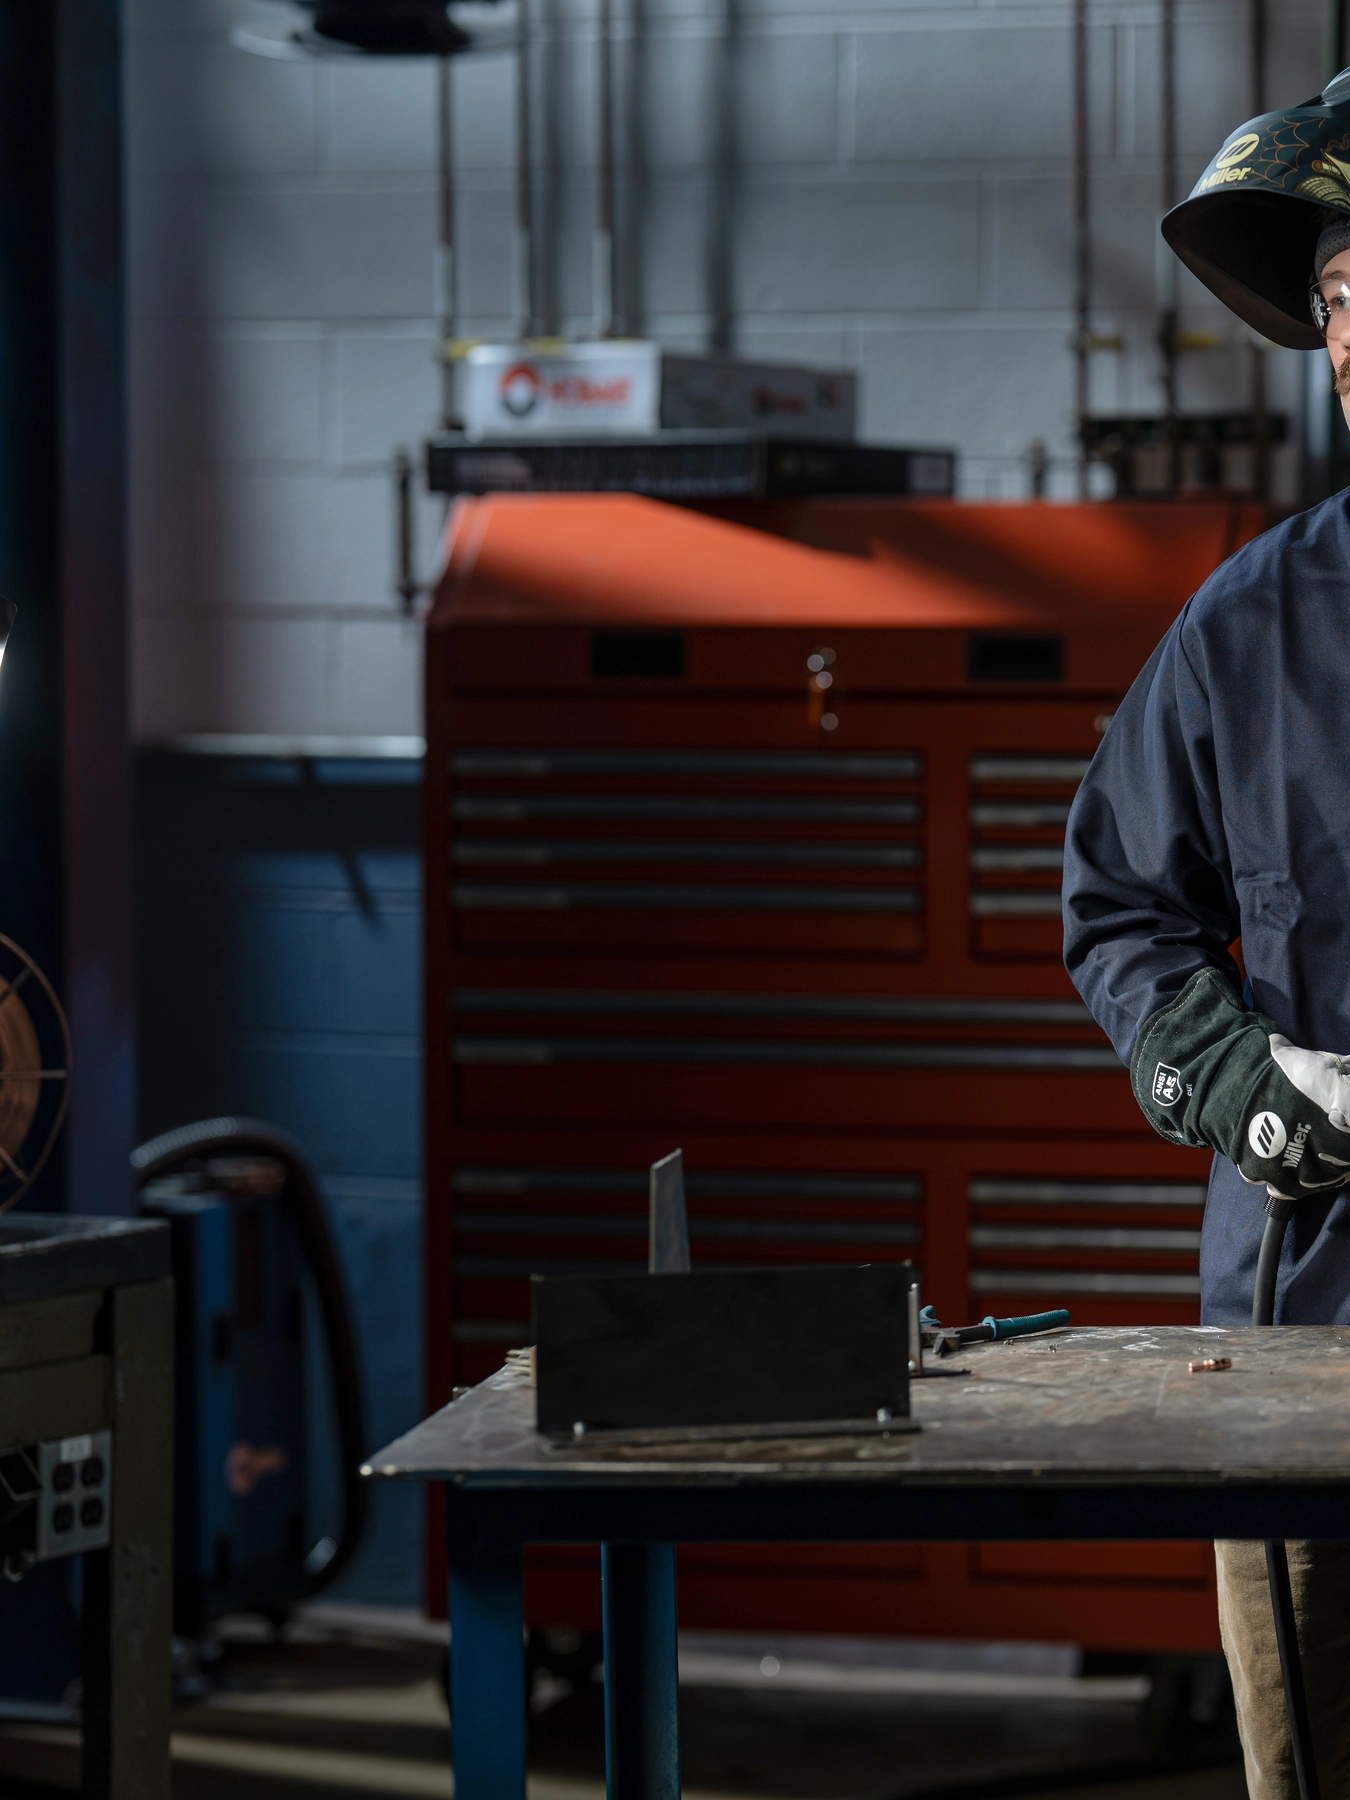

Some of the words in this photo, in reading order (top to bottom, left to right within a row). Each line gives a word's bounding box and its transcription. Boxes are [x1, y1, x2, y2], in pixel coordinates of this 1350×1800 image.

[1196, 166, 1252, 195] Miller
[1155, 1072, 1167, 1096] ANSI
[1162, 1076, 1177, 1101] A5
[1185, 1083, 1193, 1097] CUT
[1282, 1122, 1309, 1168] Miller
